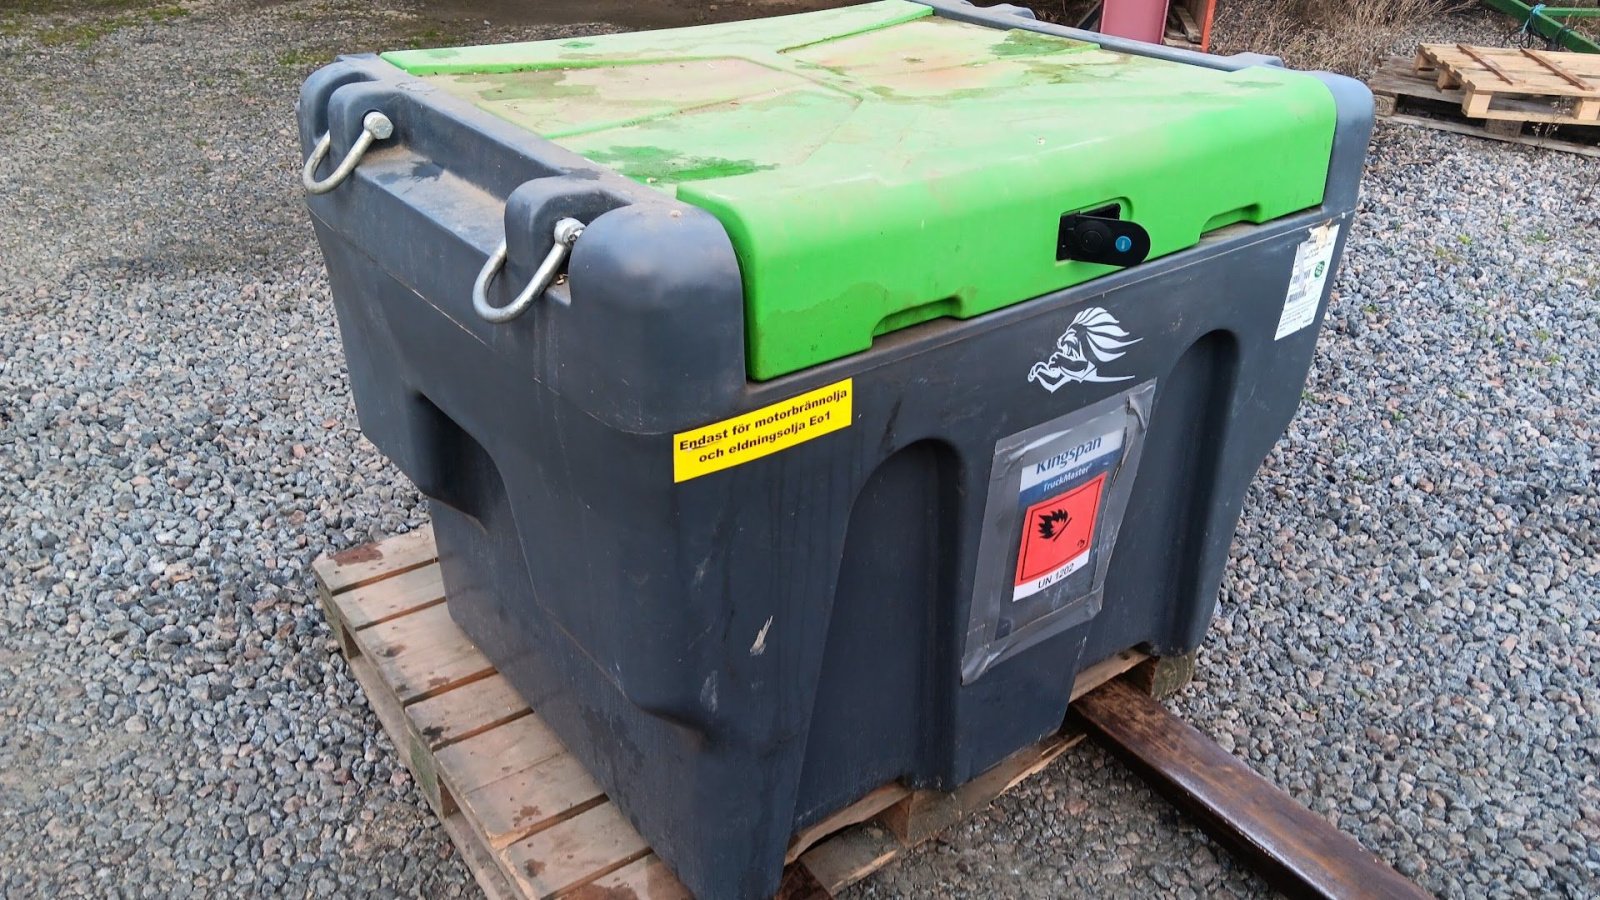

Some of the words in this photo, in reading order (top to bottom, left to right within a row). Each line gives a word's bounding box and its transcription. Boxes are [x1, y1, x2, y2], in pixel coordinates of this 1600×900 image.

[679, 430, 728, 451] Endast
[732, 423, 751, 436] för
[754, 389, 848, 429] motorbrännolja
[699, 446, 724, 463] och
[728, 422, 806, 454] eldningsolja
[809, 410, 831, 426] Eo1
[1038, 577, 1052, 589] UN
[1055, 562, 1075, 580] 1202
